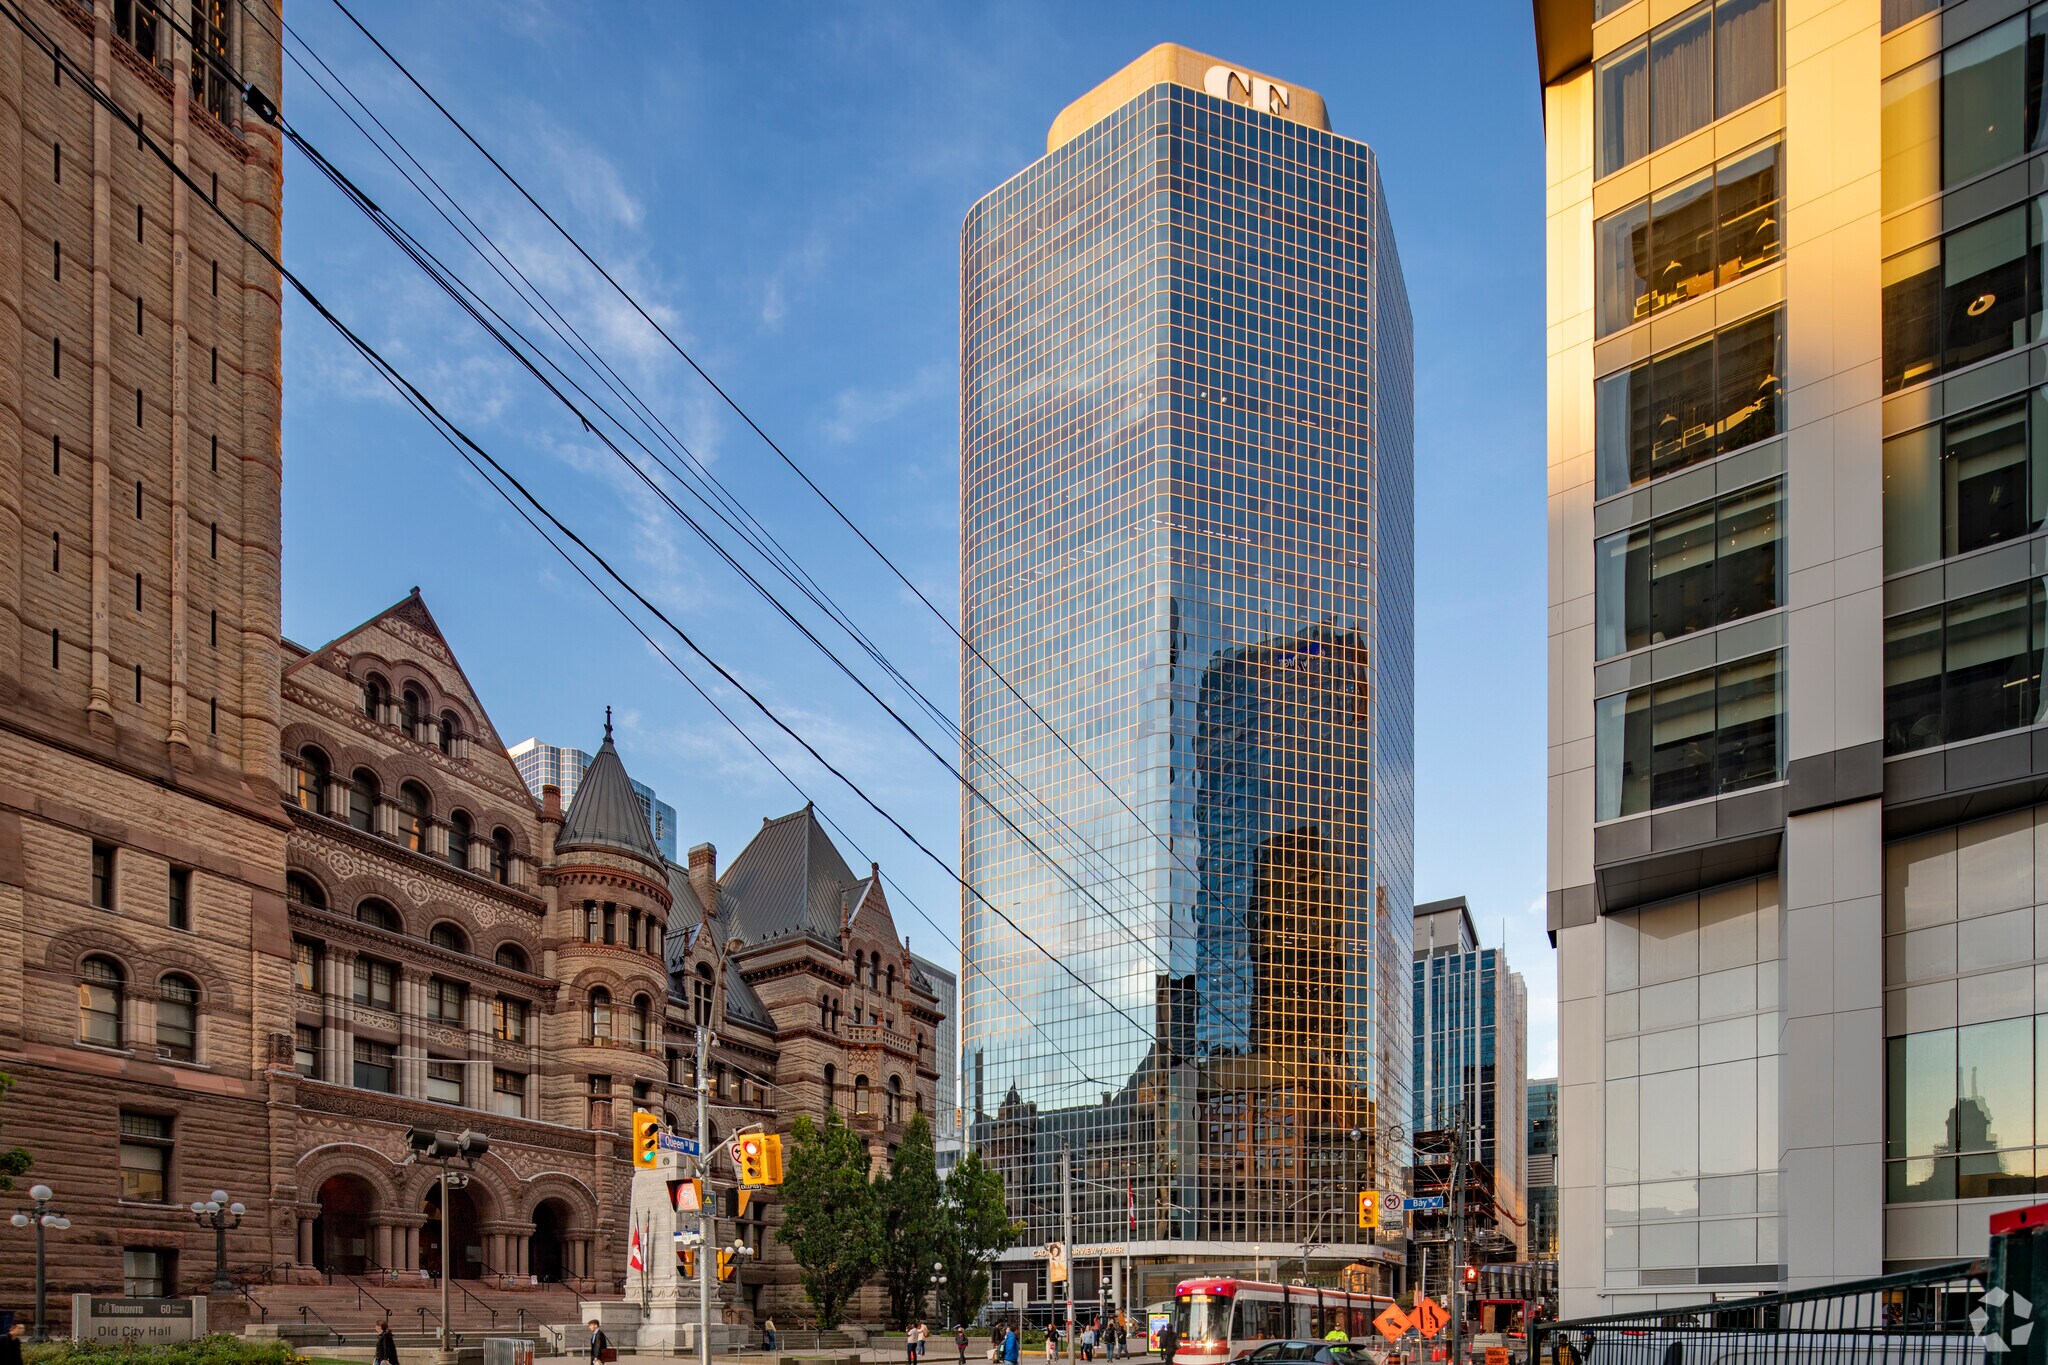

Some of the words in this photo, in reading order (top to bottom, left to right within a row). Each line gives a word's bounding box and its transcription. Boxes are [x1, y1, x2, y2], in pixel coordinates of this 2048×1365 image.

[1203, 65, 1288, 115] CF
[665, 1136, 684, 1149] Queen
[689, 1141, 695, 1152] W
[1413, 1199, 1427, 1208] Bay
[1099, 1246, 1124, 1254] TOWER
[111, 1303, 144, 1314] TORONTO
[160, 1304, 171, 1314] 60
[98, 1326, 118, 1336] Old
[122, 1326, 145, 1339] City
[148, 1326, 171, 1336] Hall
